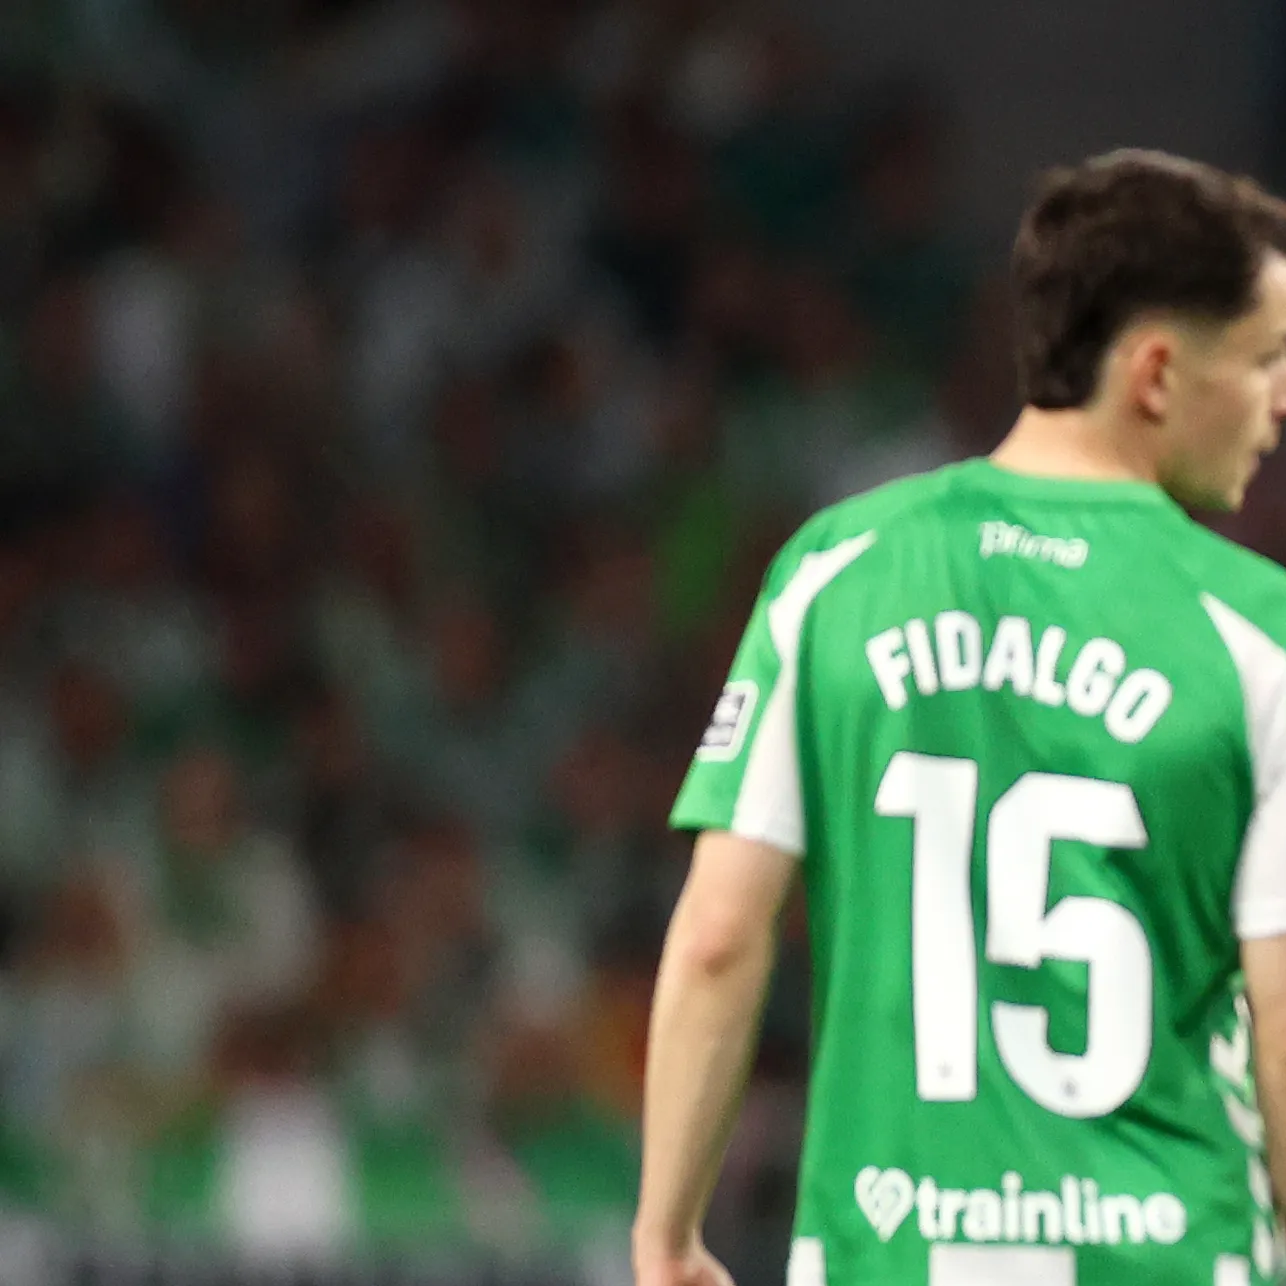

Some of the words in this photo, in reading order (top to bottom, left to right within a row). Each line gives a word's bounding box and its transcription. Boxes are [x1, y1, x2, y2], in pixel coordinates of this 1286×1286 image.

[865, 610, 1174, 744] FIDALGO
[874, 751, 1153, 1118] 15
[915, 1172, 1188, 1246] trainline
